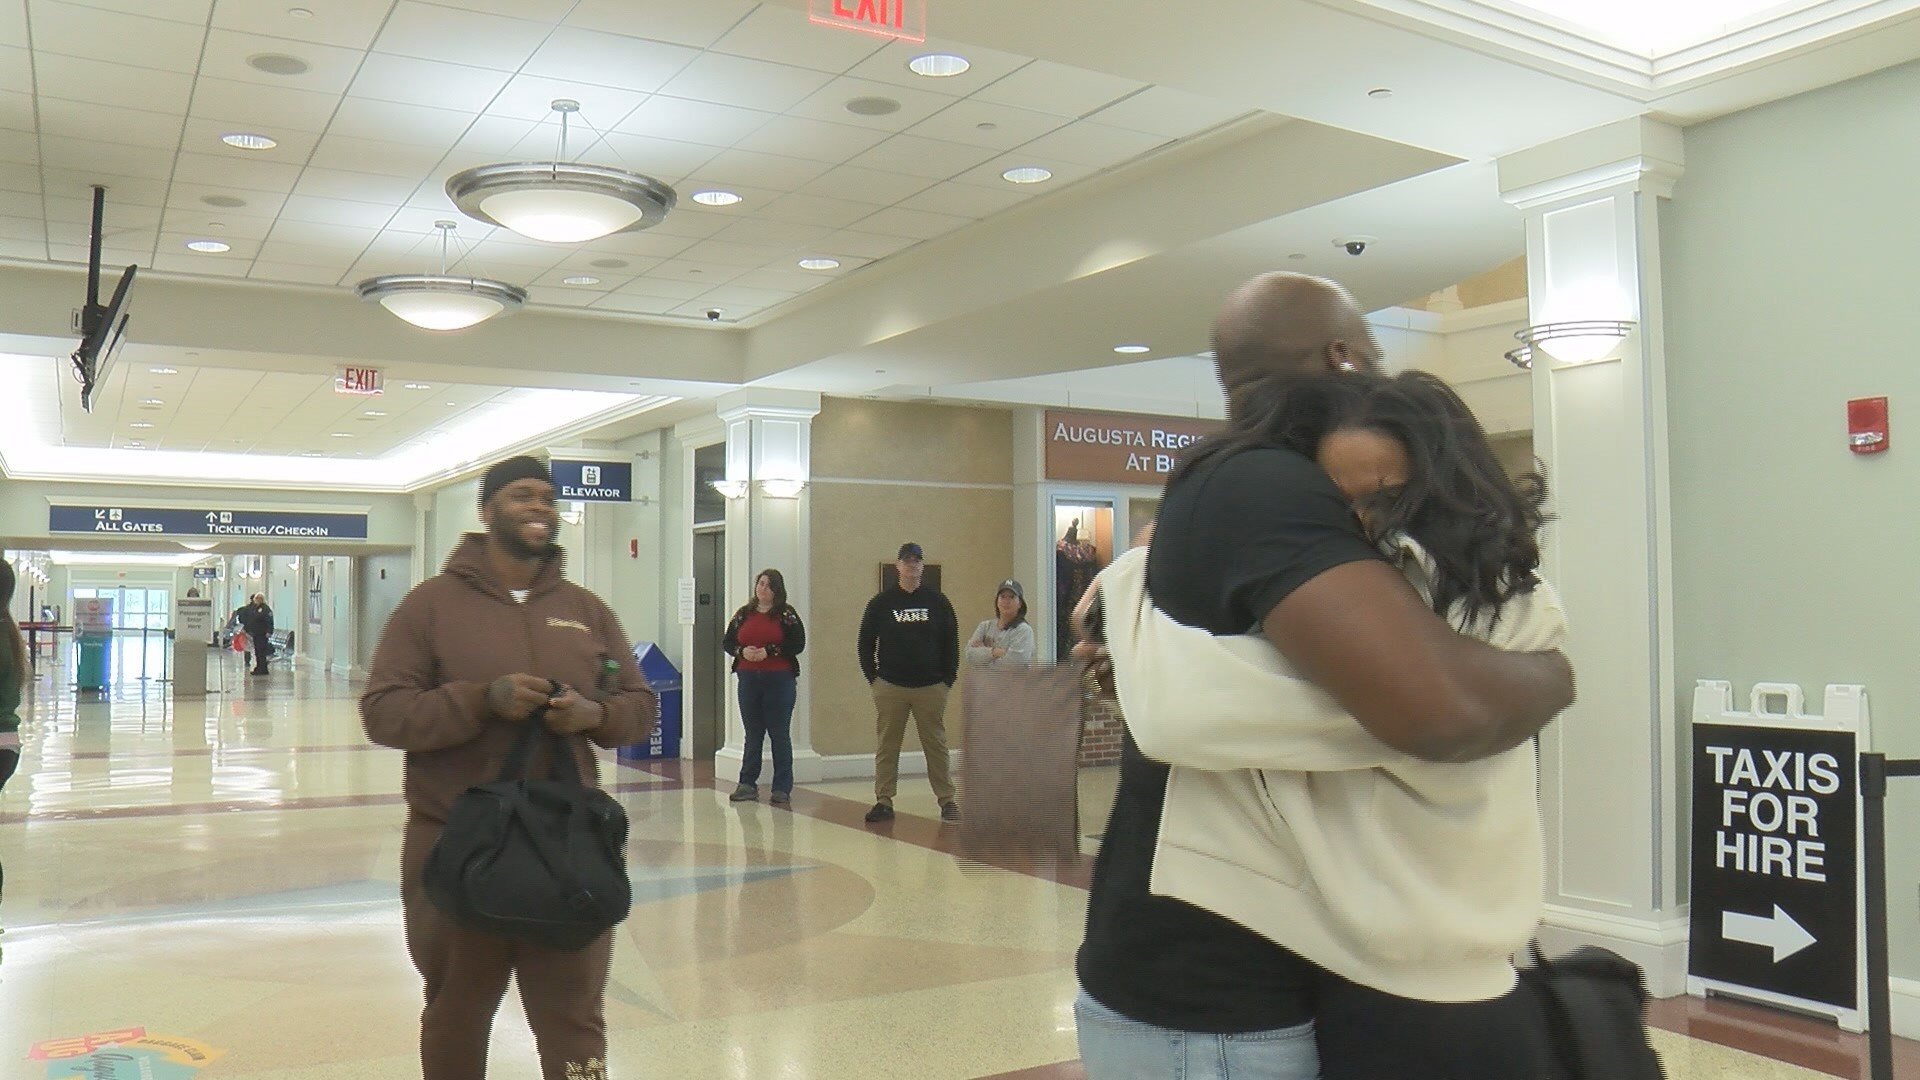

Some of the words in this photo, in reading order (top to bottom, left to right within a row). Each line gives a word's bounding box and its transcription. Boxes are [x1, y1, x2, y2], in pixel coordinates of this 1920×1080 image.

[345, 368, 378, 391] EXIT
[1053, 423, 1146, 447] AUGUSTA
[1125, 453, 1151, 472] AT
[562, 486, 621, 498] ELEVATOR
[95, 521, 120, 532] ALL
[122, 522, 164, 533] GATES
[207, 523, 329, 536] TICKETING/CHECK-IN
[892, 608, 930, 623] VANS
[1706, 746, 1839, 794] TAXIS
[1723, 790, 1818, 837] FOR
[1716, 831, 1826, 882] HIRE
